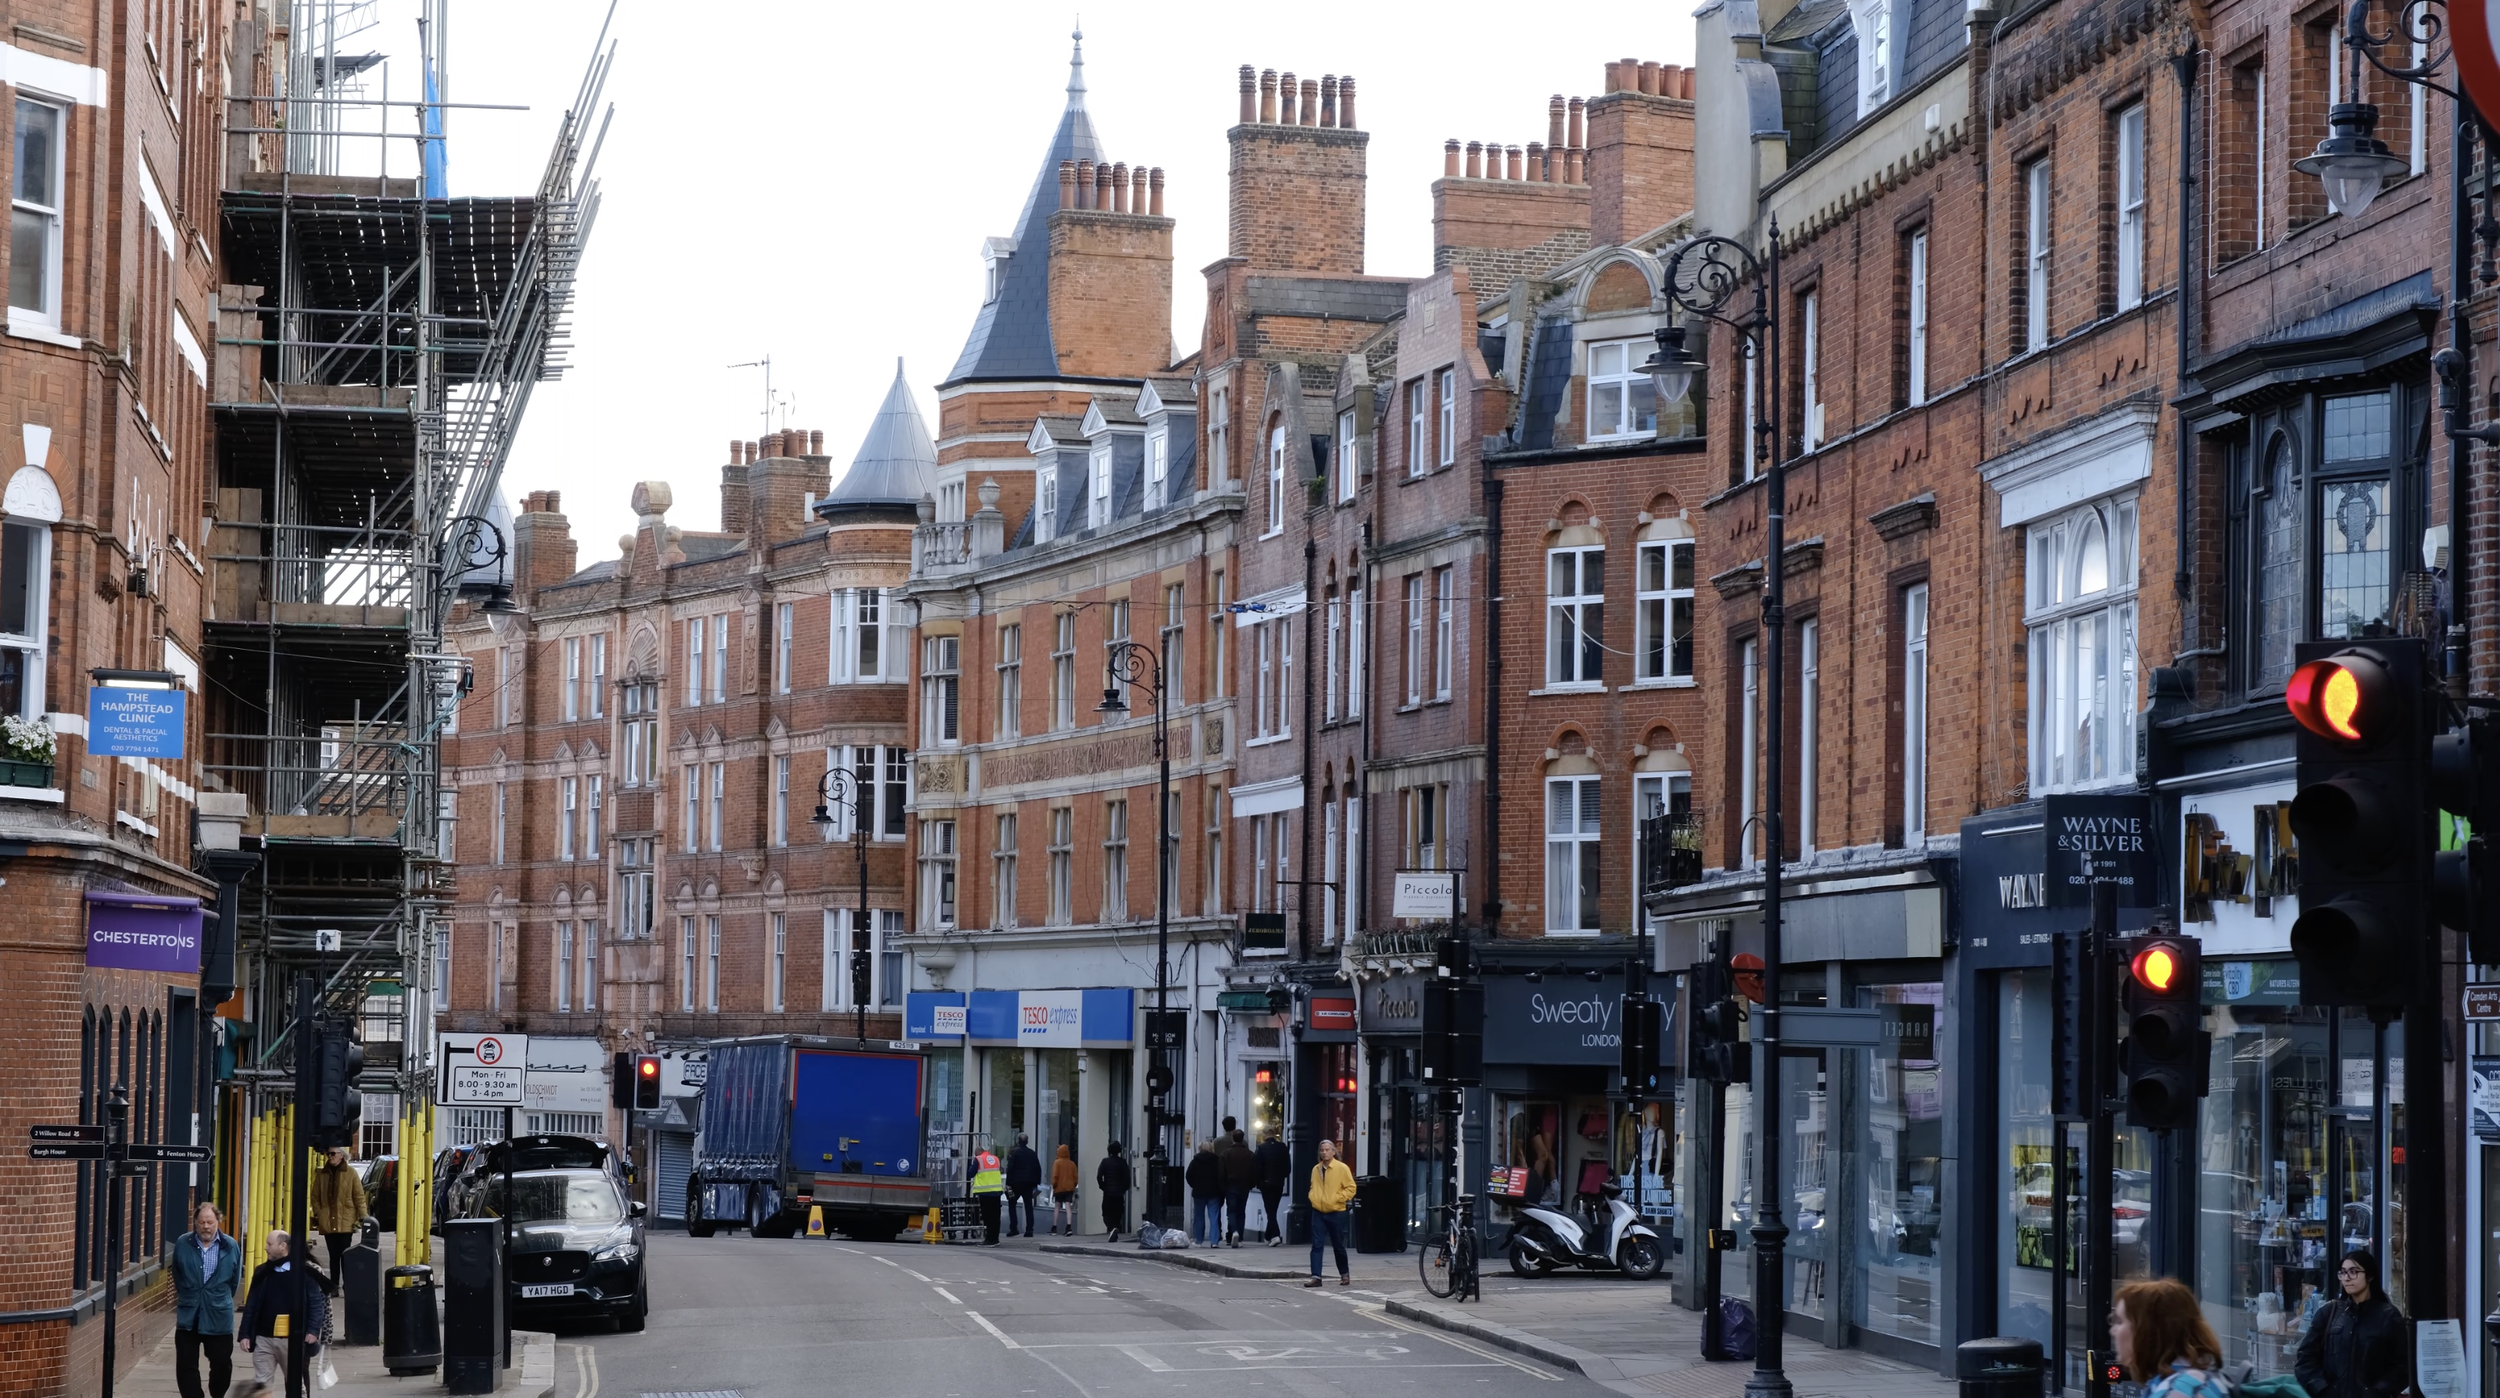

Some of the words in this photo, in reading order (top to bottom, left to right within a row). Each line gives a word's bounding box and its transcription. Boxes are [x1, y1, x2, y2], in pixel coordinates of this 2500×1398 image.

[127, 693, 149, 702] THE
[101, 702, 173, 714] HAMPSTEAD
[118, 713, 156, 724] CLINIC
[103, 726, 132, 734] DENTAL
[142, 728, 168, 736] FACIAL
[113, 733, 158, 742] AESTHETICS
[983, 754, 1034, 788] EXPRESS
[1043, 748, 1077, 780] DAIRY
[1086, 738, 1142, 775] COMPANY
[1150, 727, 1192, 764] LITED
[2063, 817, 2141, 833] WAYNE
[2069, 876, 2085, 884] 020
[1404, 883, 1452, 894] Piccola
[1999, 873, 2044, 909] WAYNE
[93, 930, 194, 948] CHESTERTONS
[2228, 981, 2239, 995] CBD
[1377, 985, 1415, 1018] Piccola
[2470, 992, 2488, 1002] Camden
[2488, 991, 2498, 1001] Arts
[1531, 993, 1613, 1031] Sweaty
[2476, 1003, 2492, 1013] Centre
[1023, 1006, 1048, 1025] TESCO
[1050, 1005, 1077, 1031] express
[937, 1021, 964, 1029] express
[471, 1070, 489, 1079] Mon
[495, 1071, 506, 1079] Fri
[458, 1080, 479, 1088] 8.00
[472, 1089, 478, 1097] 3
[483, 1089, 490, 1097] 4
[491, 1090, 503, 1098] pm
[526, 1084, 558, 1096] OLDSCHMIDT
[39, 1130, 57, 1138] Willow
[58, 1130, 71, 1138] Road
[34, 1147, 50, 1156] Burgh
[167, 1150, 186, 1158] Fenton
[187, 1151, 204, 1159] House
[528, 1286, 548, 1296] YA17
[550, 1285, 569, 1295] HGD
